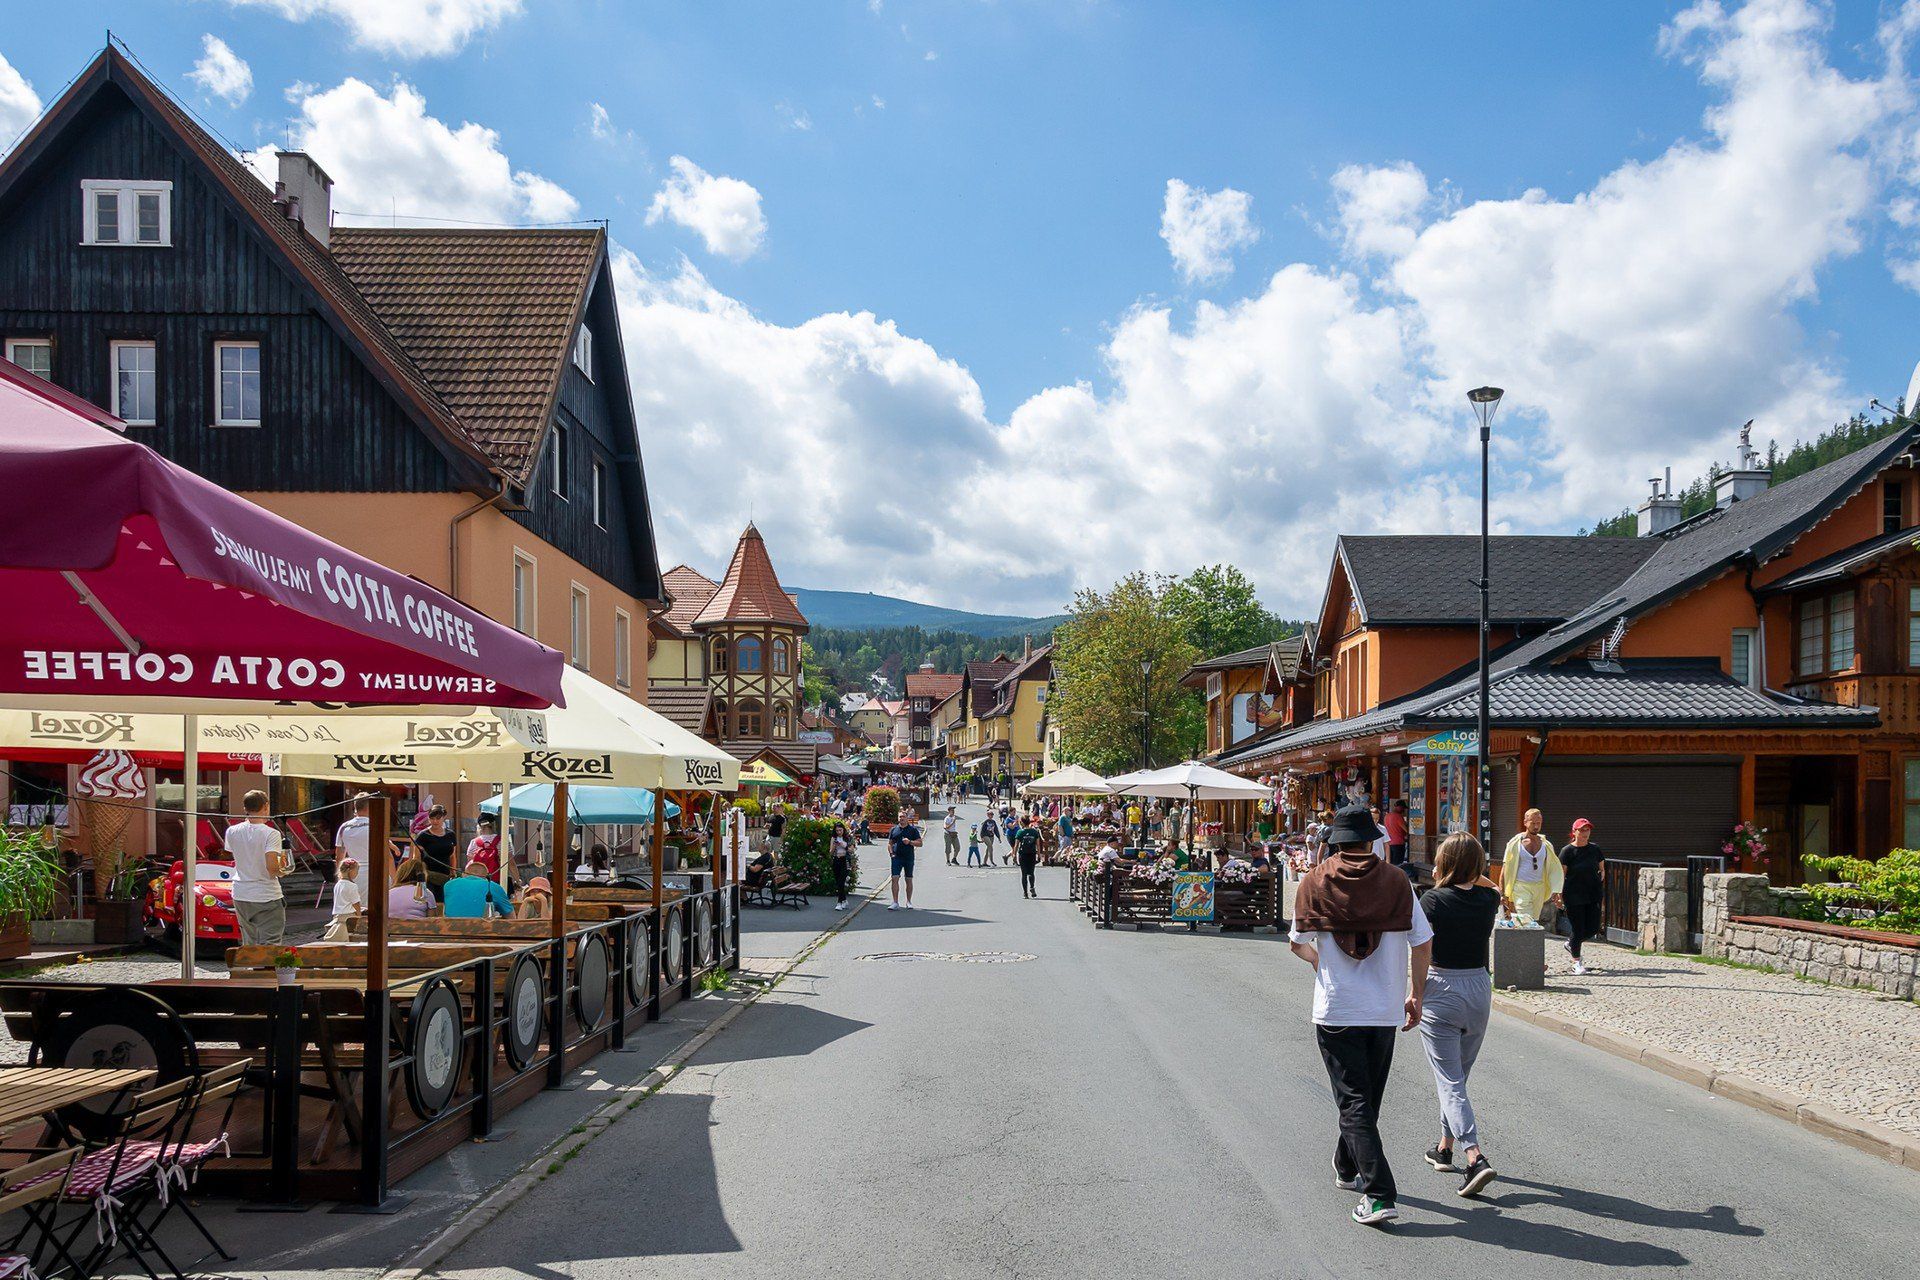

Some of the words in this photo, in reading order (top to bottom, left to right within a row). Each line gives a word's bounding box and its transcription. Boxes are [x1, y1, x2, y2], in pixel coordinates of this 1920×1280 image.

[211, 527, 313, 594] SERWUJEMY
[317, 558, 402, 627] COSTA
[403, 594, 479, 658] COFFEE
[1427, 739, 1464, 752] Gofry
[521, 750, 614, 780] Kozel
[684, 758, 723, 786] Kozel
[1176, 875, 1211, 884] GOFRY
[1175, 908, 1211, 917] GOFRY
